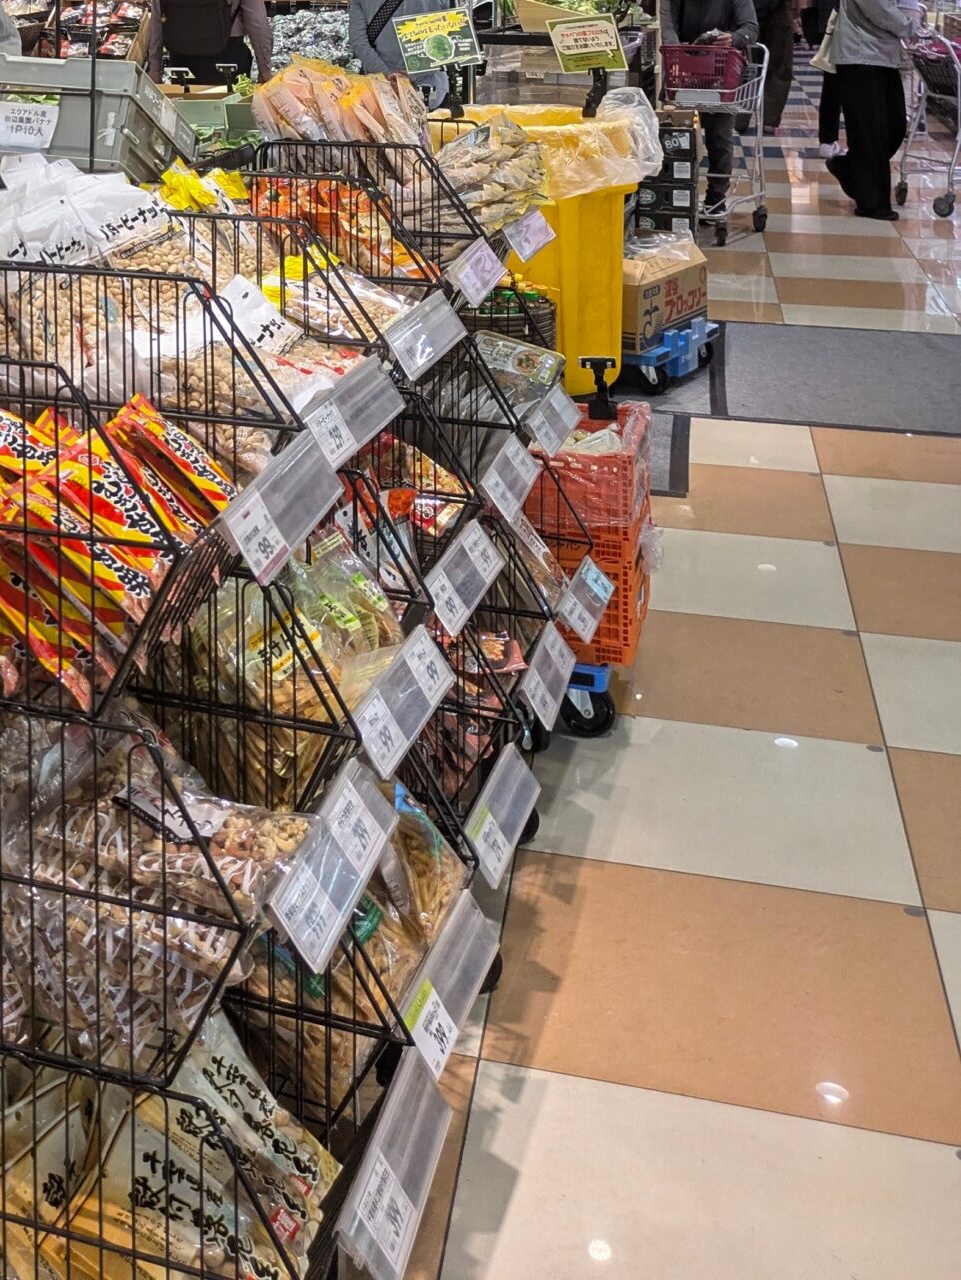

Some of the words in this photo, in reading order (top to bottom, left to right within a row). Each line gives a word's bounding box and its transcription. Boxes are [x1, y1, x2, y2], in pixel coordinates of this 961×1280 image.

[664, 137, 680, 150] 80
[664, 287, 708, 324] ブロッコリー
[257, 536, 276, 561] 99
[426, 660, 440, 685] 99
[379, 724, 394, 753] 99
